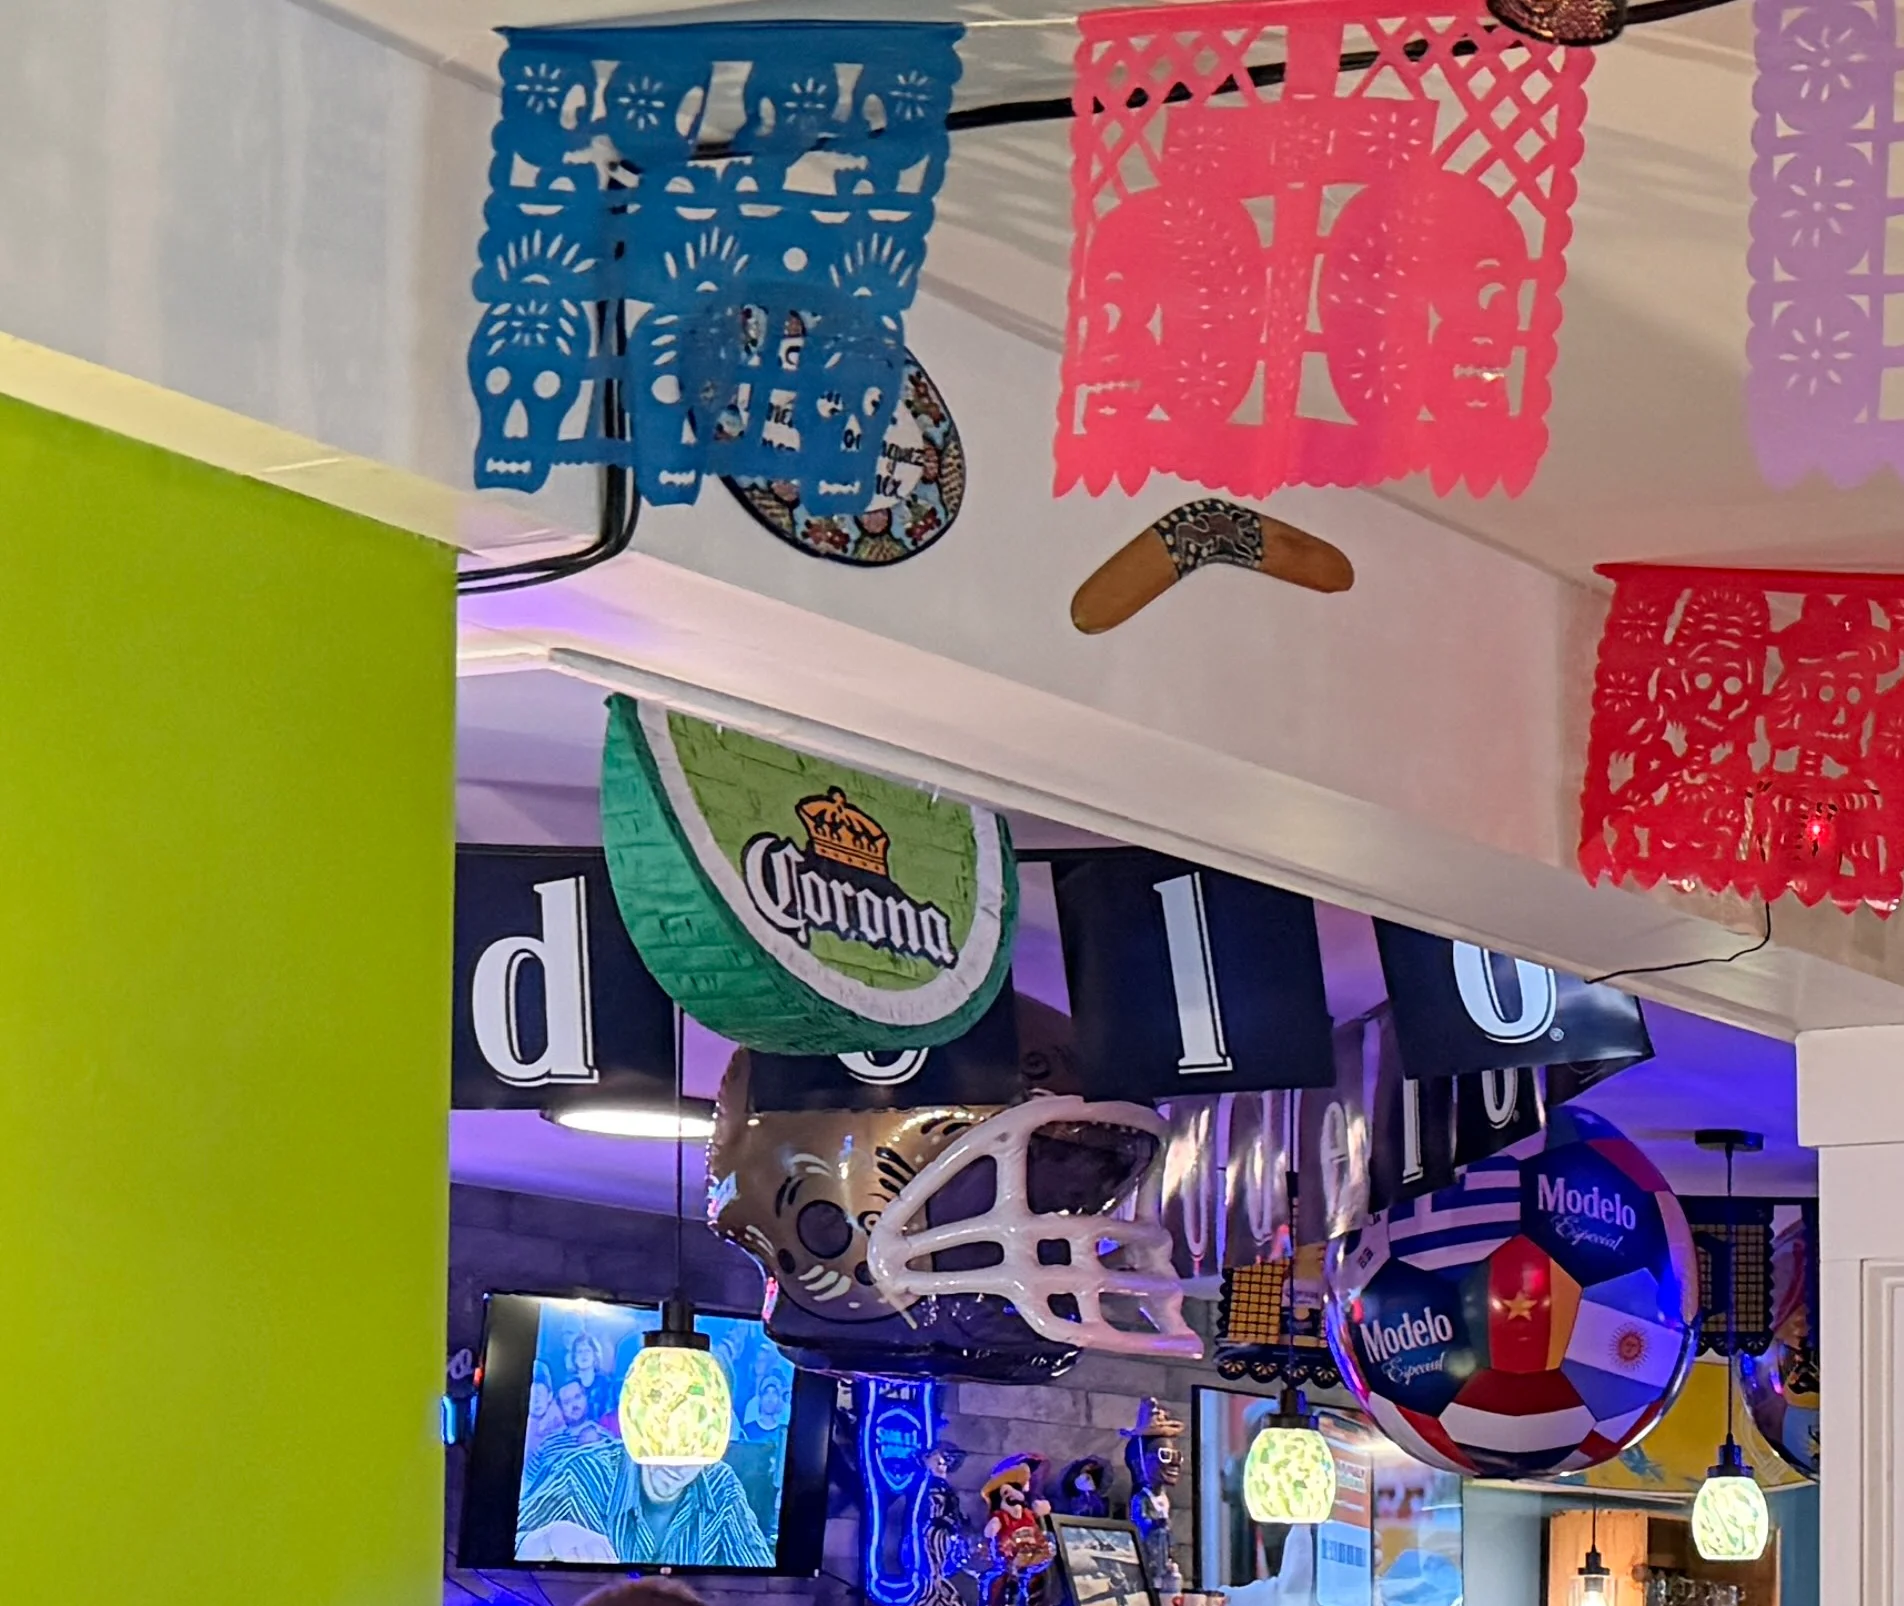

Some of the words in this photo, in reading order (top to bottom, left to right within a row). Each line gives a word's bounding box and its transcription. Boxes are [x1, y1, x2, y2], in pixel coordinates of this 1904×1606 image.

[744, 835, 956, 966] Corona
[1538, 1174, 1637, 1231] Modelo
[1552, 1216, 1623, 1251] Especial
[1360, 1307, 1453, 1364] Modelo
[1381, 1351, 1446, 1386] Especial
